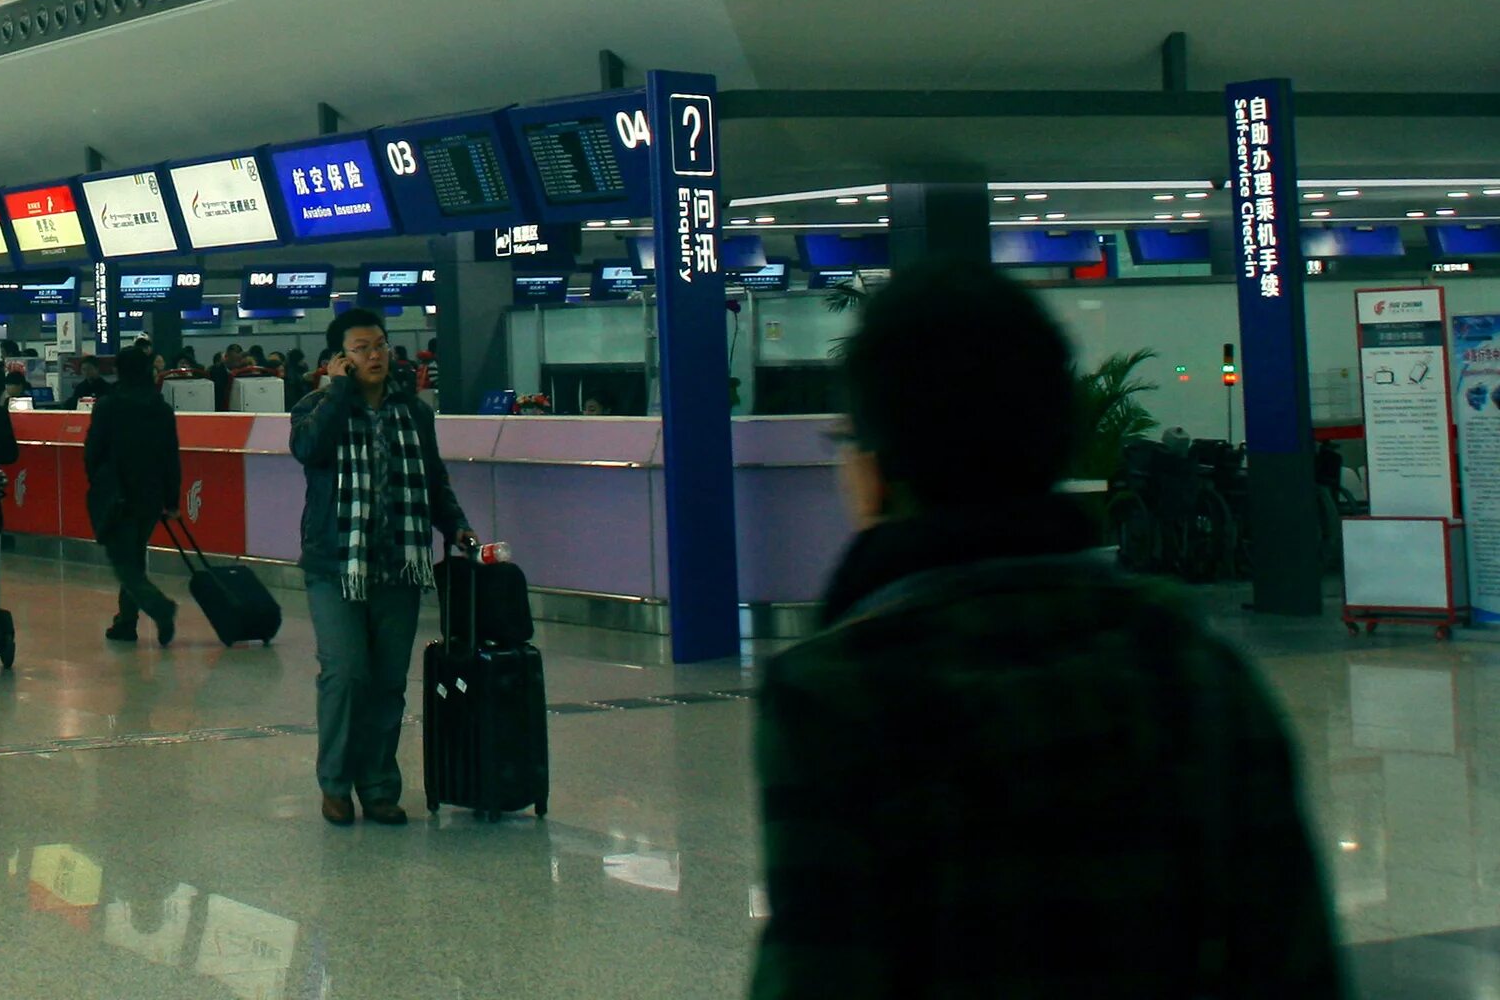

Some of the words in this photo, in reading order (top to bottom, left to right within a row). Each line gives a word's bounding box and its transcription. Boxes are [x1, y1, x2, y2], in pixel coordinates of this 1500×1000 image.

[615, 110, 650, 149] 04
[1234, 99, 1252, 198] Self-service
[387, 140, 418, 176] 03
[292, 160, 365, 196] 航空保险
[1250, 96, 1280, 298] 自助办理乘机手续
[303, 205, 333, 220] Aviation
[334, 202, 372, 216] Insurance
[693, 187, 718, 274] 问讯
[677, 187, 694, 283] Enquiry
[1241, 201, 1258, 278] Check-in
[177, 273, 201, 286] R03
[250, 272, 274, 286] R04
